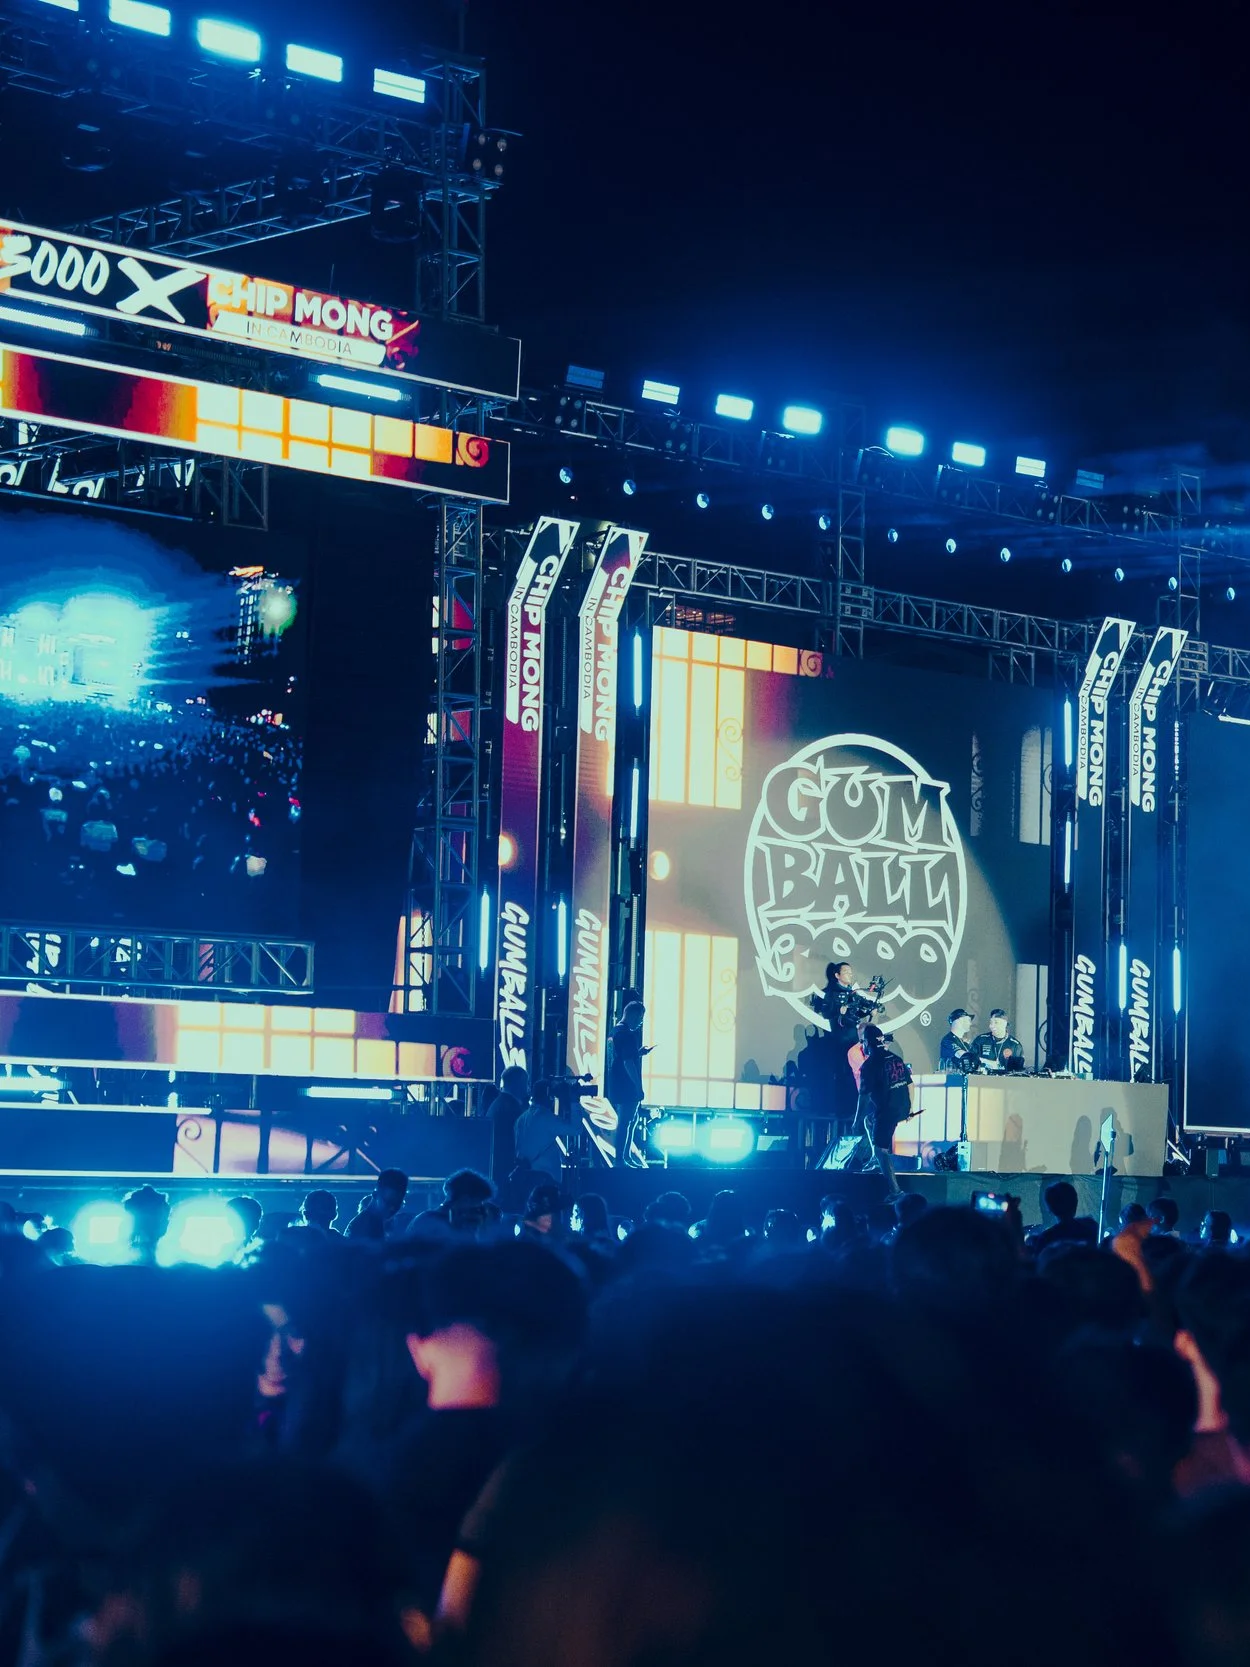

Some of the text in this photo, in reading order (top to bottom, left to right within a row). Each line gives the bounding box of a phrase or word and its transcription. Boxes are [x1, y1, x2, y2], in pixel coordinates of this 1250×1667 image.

[115, 256, 208, 324] X
[208, 273, 288, 316] CHIP
[294, 292, 394, 341] MONG
[246, 320, 352, 355] IN CAMBODIA
[509, 586, 525, 689] IN CAMBODIA
[520, 554, 560, 733] CHIP MONG
[583, 597, 598, 699] IN CAMBODIA
[594, 565, 630, 742] CHIP MONG
[1079, 679, 1092, 769] IN CAMBODIA
[1088, 651, 1119, 807] CHIP MONG
[1132, 687, 1144, 776] IN CAMBODIA
[1141, 660, 1171, 813] CHIP MONG
[756, 838, 954, 916] BALL
[1129, 959, 1150, 1075] GUMBAL
